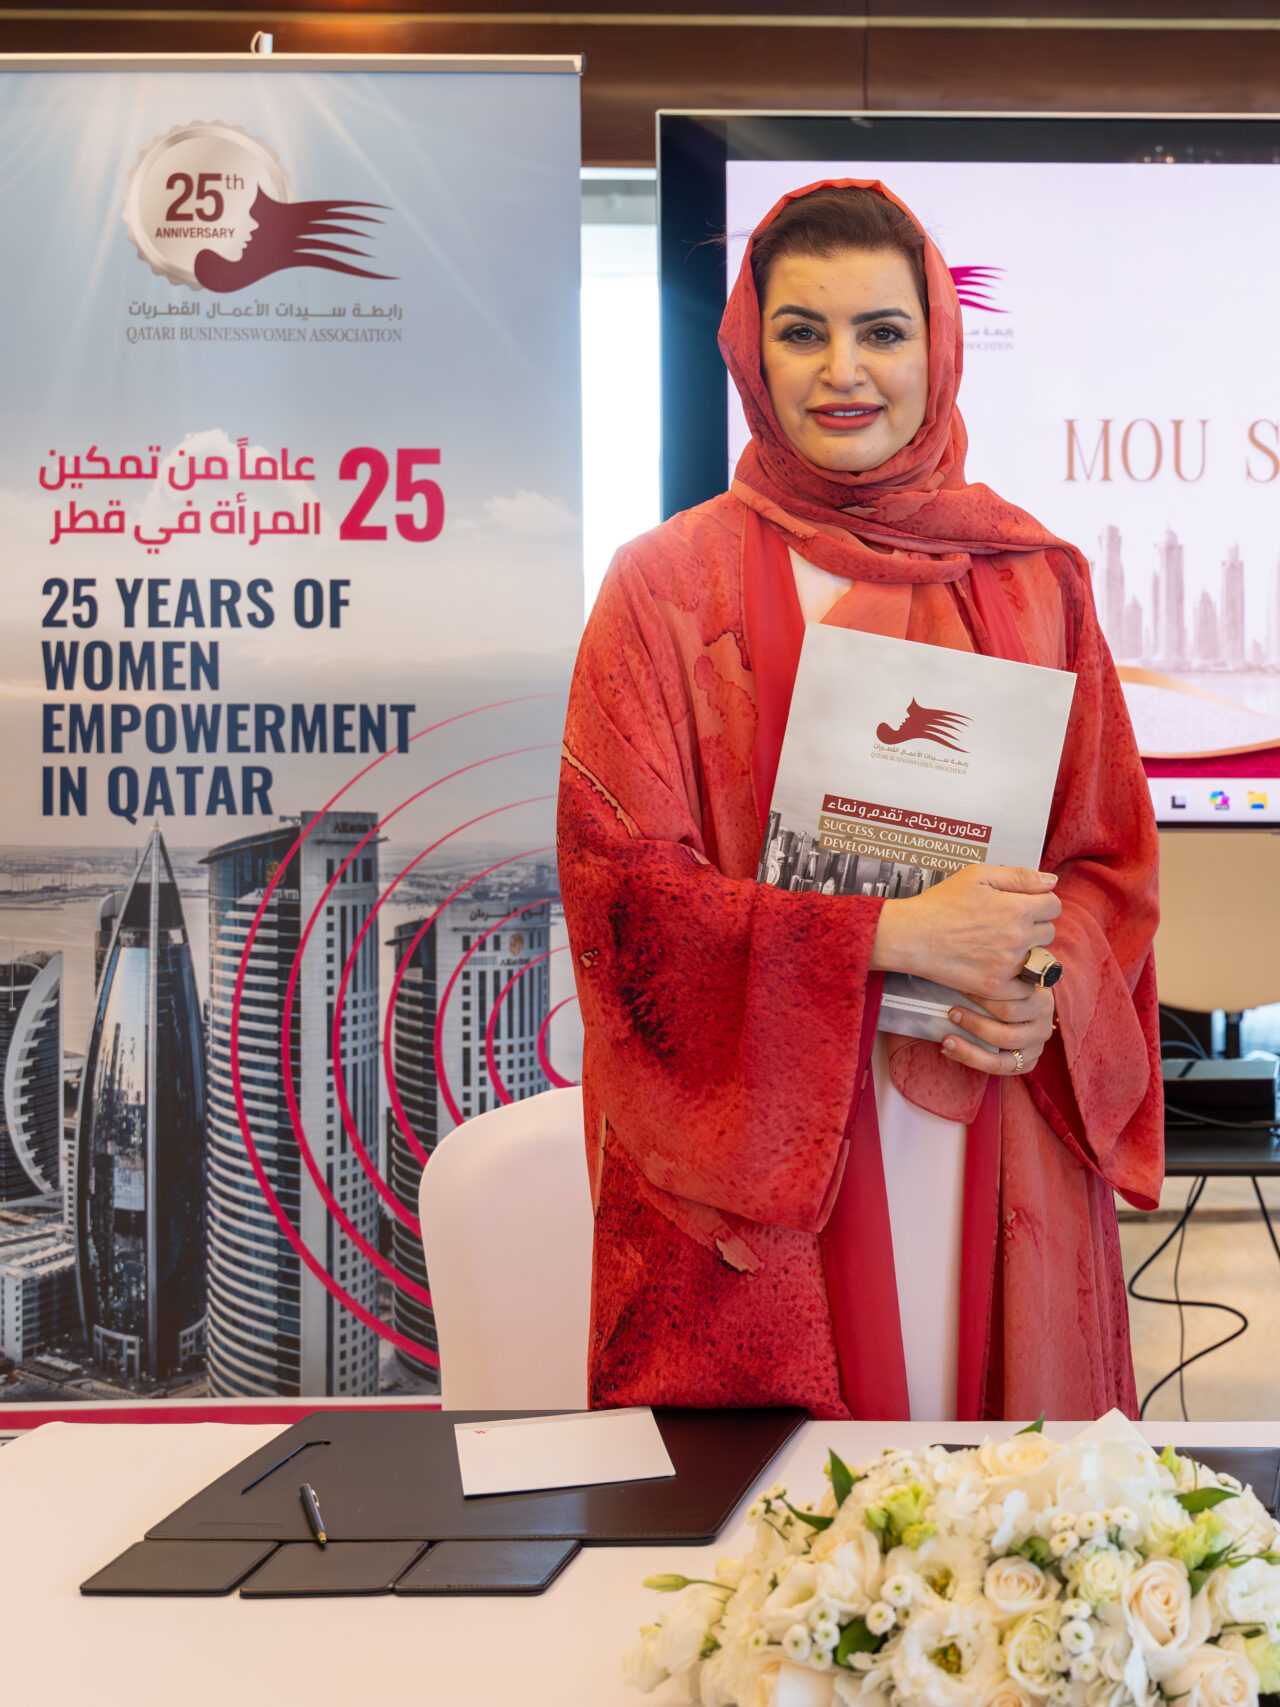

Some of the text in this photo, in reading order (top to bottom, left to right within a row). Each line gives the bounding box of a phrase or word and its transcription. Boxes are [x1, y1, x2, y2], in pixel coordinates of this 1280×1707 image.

[155, 227, 235, 239] ANNIVERSARY
[128, 301, 200, 320] القطريات
[206, 299, 269, 320] الأعمال
[352, 302, 403, 321] رابطة
[126, 326, 403, 344] QATARI BUSINESSWOMEN ASSOCIATION
[39, 445, 160, 490] تمكين
[168, 449, 229, 490] من
[1064, 418, 1210, 484] MOU
[338, 446, 445, 543] 25
[50, 492, 321, 555] المرأة في قطر
[41, 578, 351, 628] 25 YEARS OF
[41, 641, 219, 691] WOMEN
[41, 704, 416, 754] EMPOWERMENT
[42, 766, 273, 825] IN QATAR
[823, 819, 982, 860] SUCCESS, COLLABORATION,
[823, 836, 968, 873] DEVELOPMENT & GROWT
